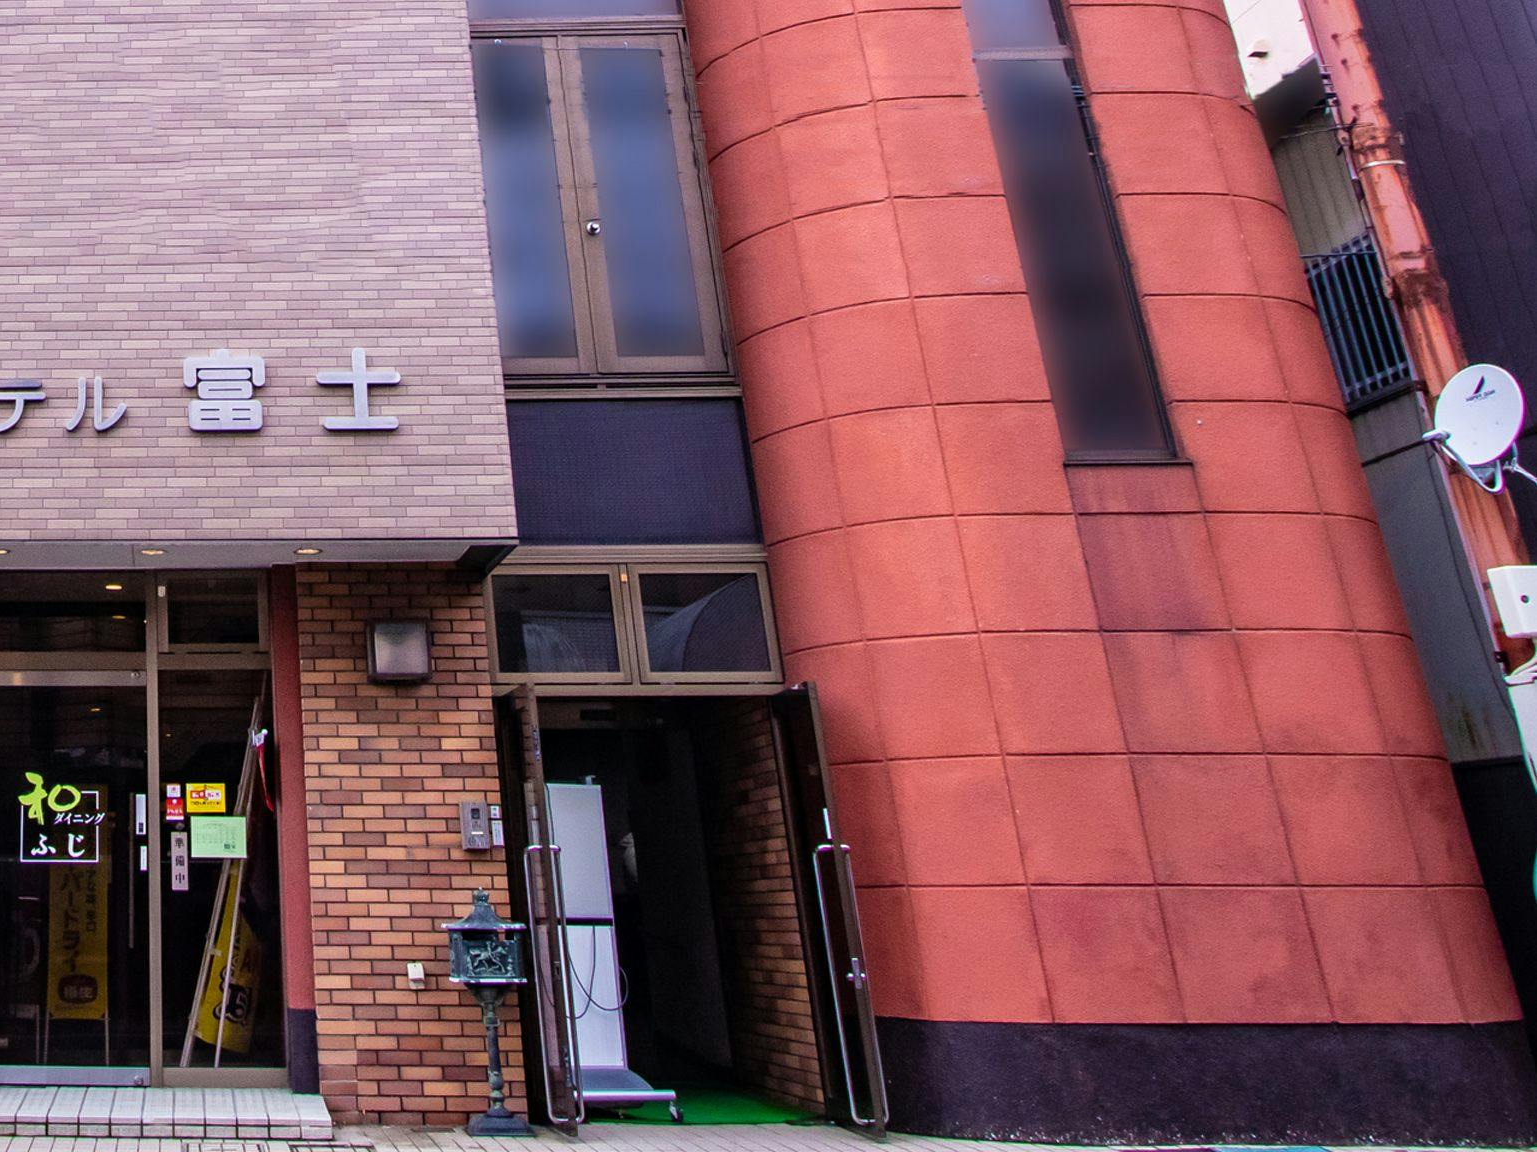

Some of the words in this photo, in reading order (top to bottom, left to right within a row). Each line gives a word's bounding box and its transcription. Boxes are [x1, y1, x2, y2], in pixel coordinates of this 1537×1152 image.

[18, 772, 81, 825] 和
[54, 812, 105, 825] ダイニング
[31, 833, 85, 858] ふじ
